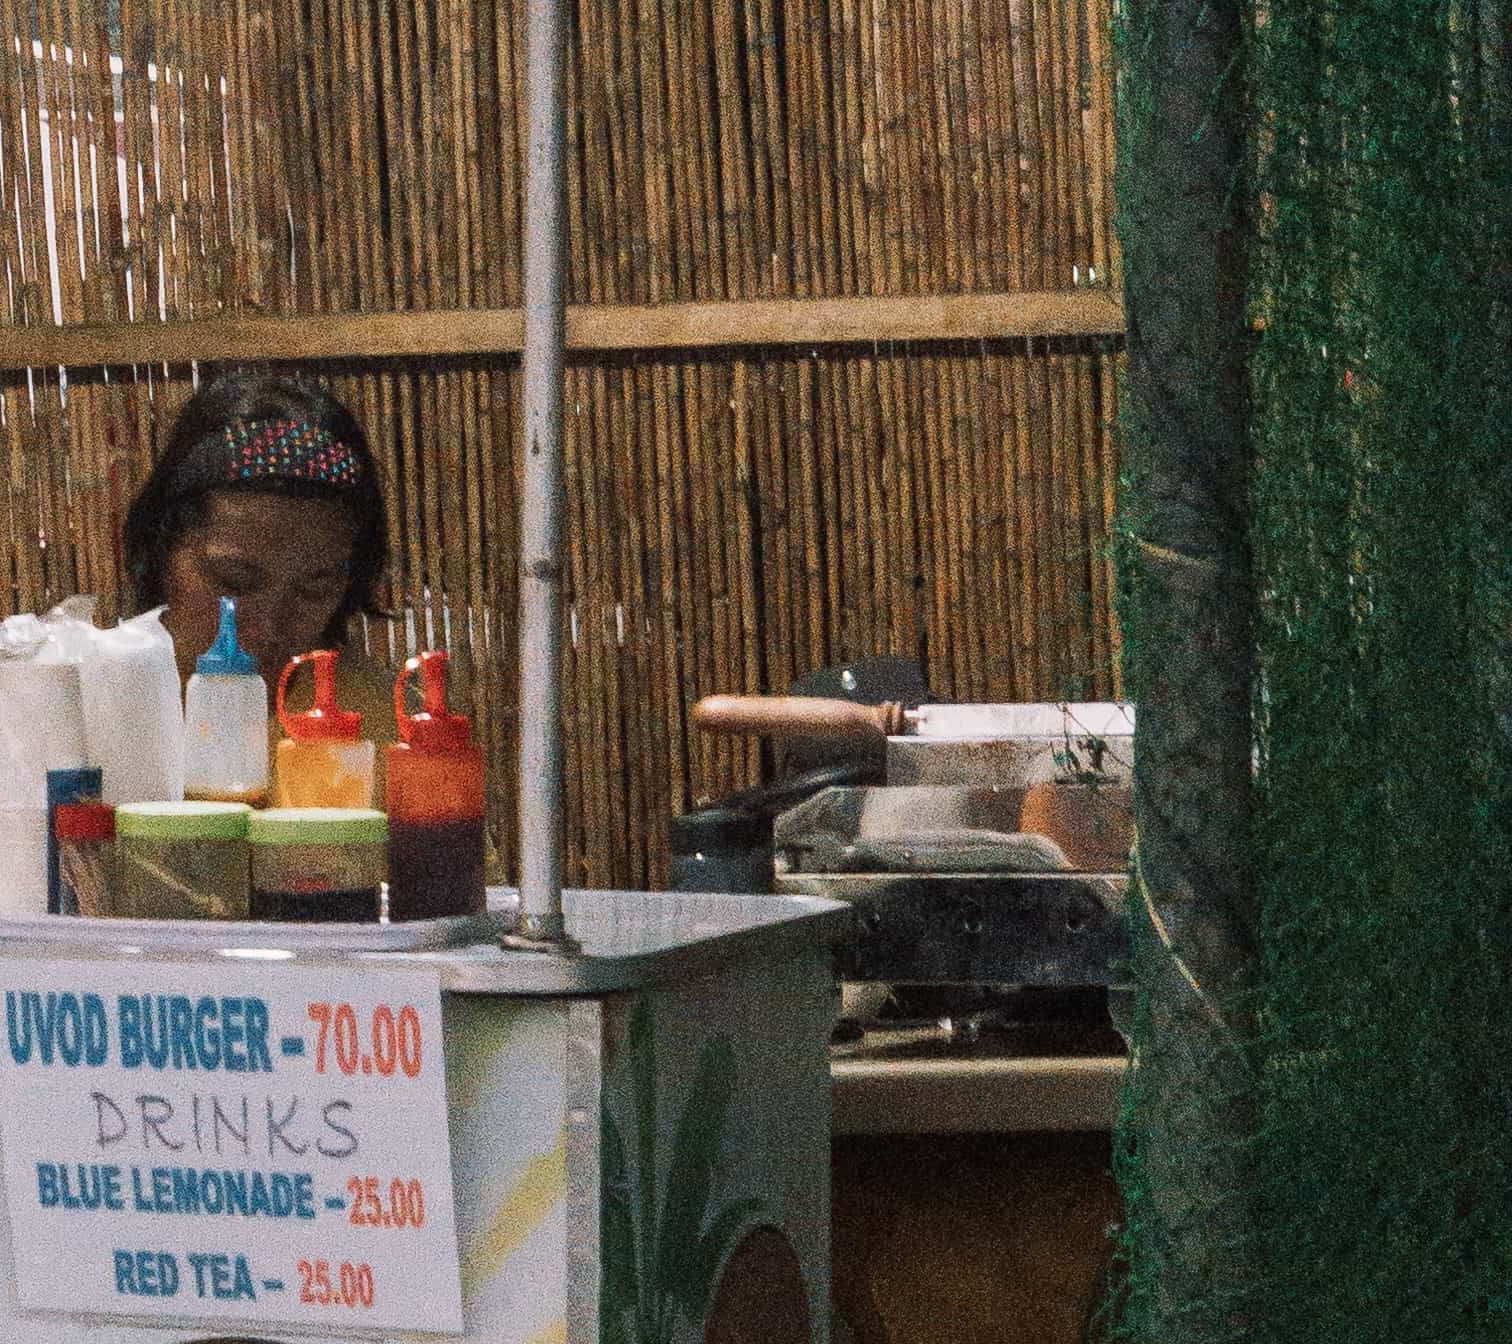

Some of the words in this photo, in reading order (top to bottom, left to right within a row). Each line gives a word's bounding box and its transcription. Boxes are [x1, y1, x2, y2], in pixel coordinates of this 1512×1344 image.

[5, 990, 107, 1066] UVOD
[117, 993, 274, 1074] BURGER
[91, 1091, 360, 1159] DRINKS
[35, 1161, 126, 1212] BLUE
[131, 1165, 316, 1220] LEMONADE
[113, 1249, 180, 1299] RED
[188, 1253, 257, 1302] TEA
